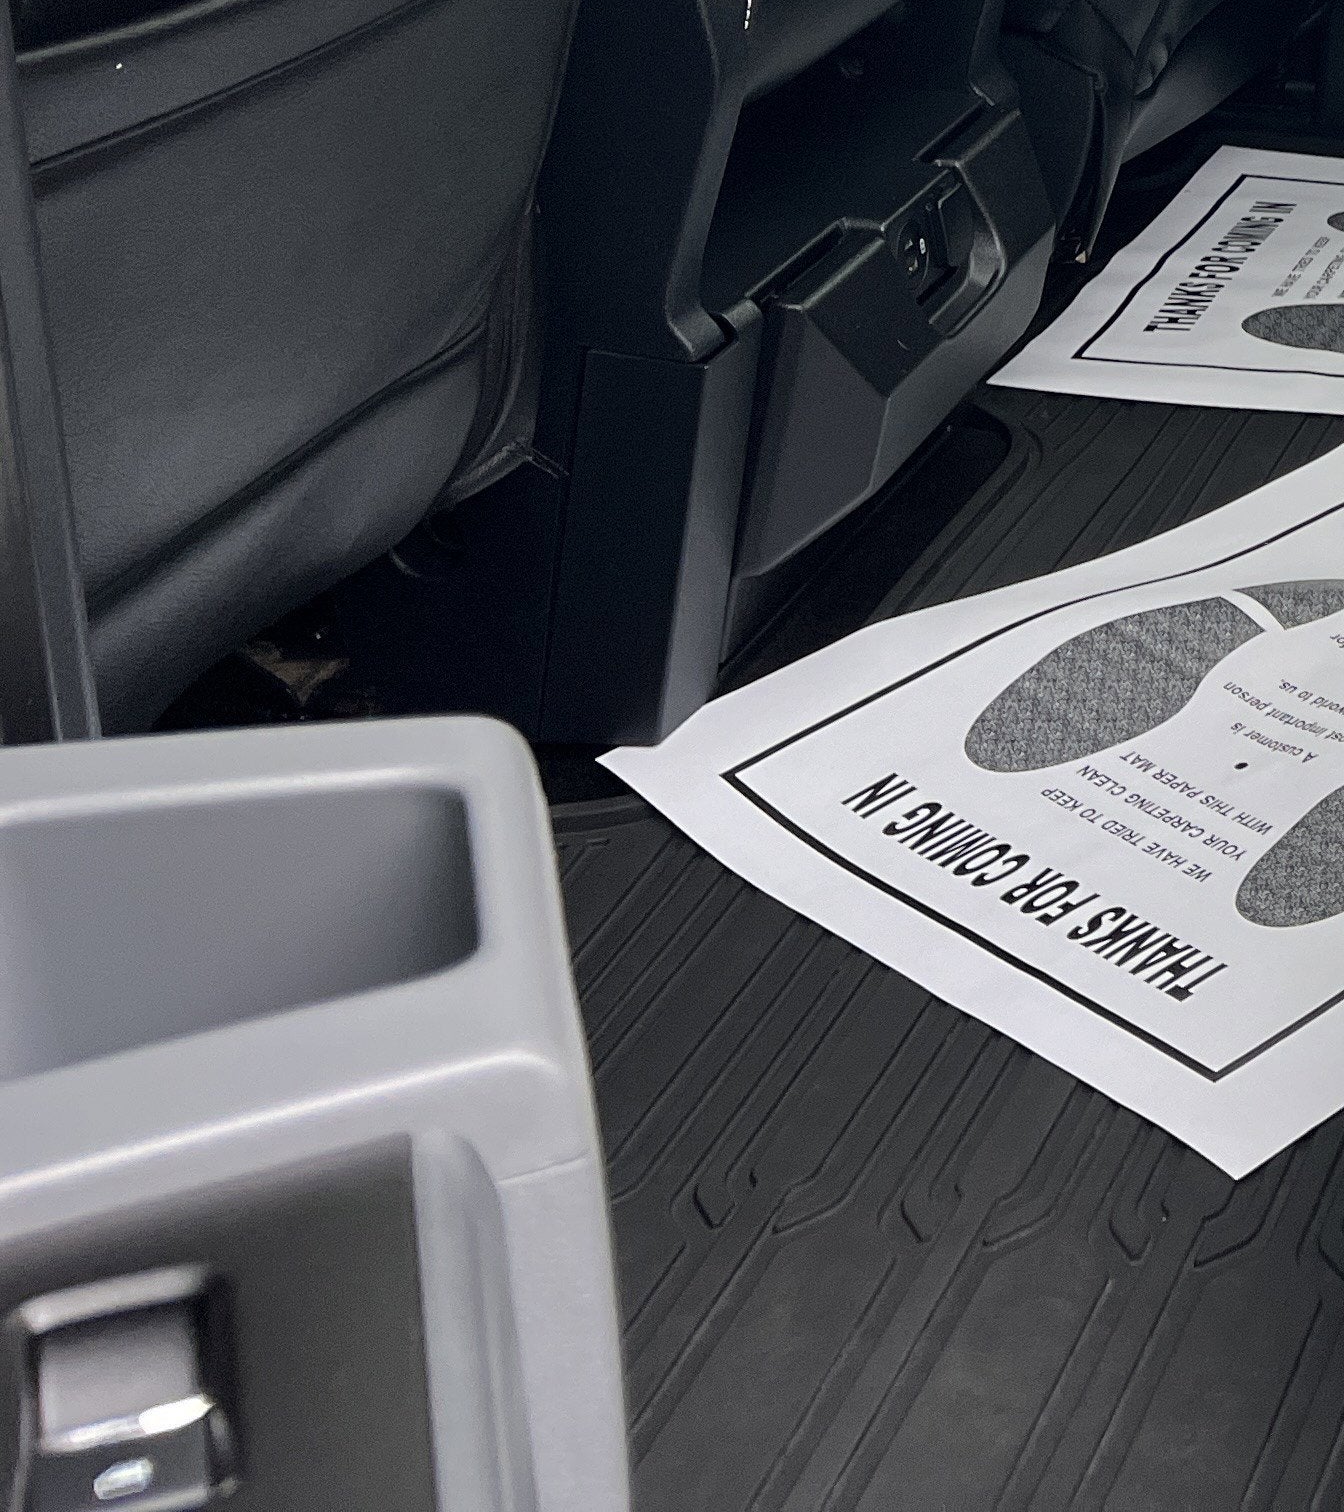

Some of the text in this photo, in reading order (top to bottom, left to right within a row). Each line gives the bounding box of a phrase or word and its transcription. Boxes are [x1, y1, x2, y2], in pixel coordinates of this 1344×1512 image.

[1143, 201, 1297, 331] THANKS FOR COMING IN
[1224, 682, 1272, 710] person
[1279, 679, 1297, 693] us.
[1298, 691, 1313, 701] to
[1231, 723, 1319, 763] A customer is
[1266, 708, 1328, 734] important
[1077, 766, 1247, 861] YOUR CARPETING CLEAN
[1119, 751, 1273, 835] WITH THIS PAPER MAT
[1041, 789, 1212, 882] WE HAVE TRIED TO KEEP
[842, 773, 1227, 1002] THANKS FOR COMING IN
